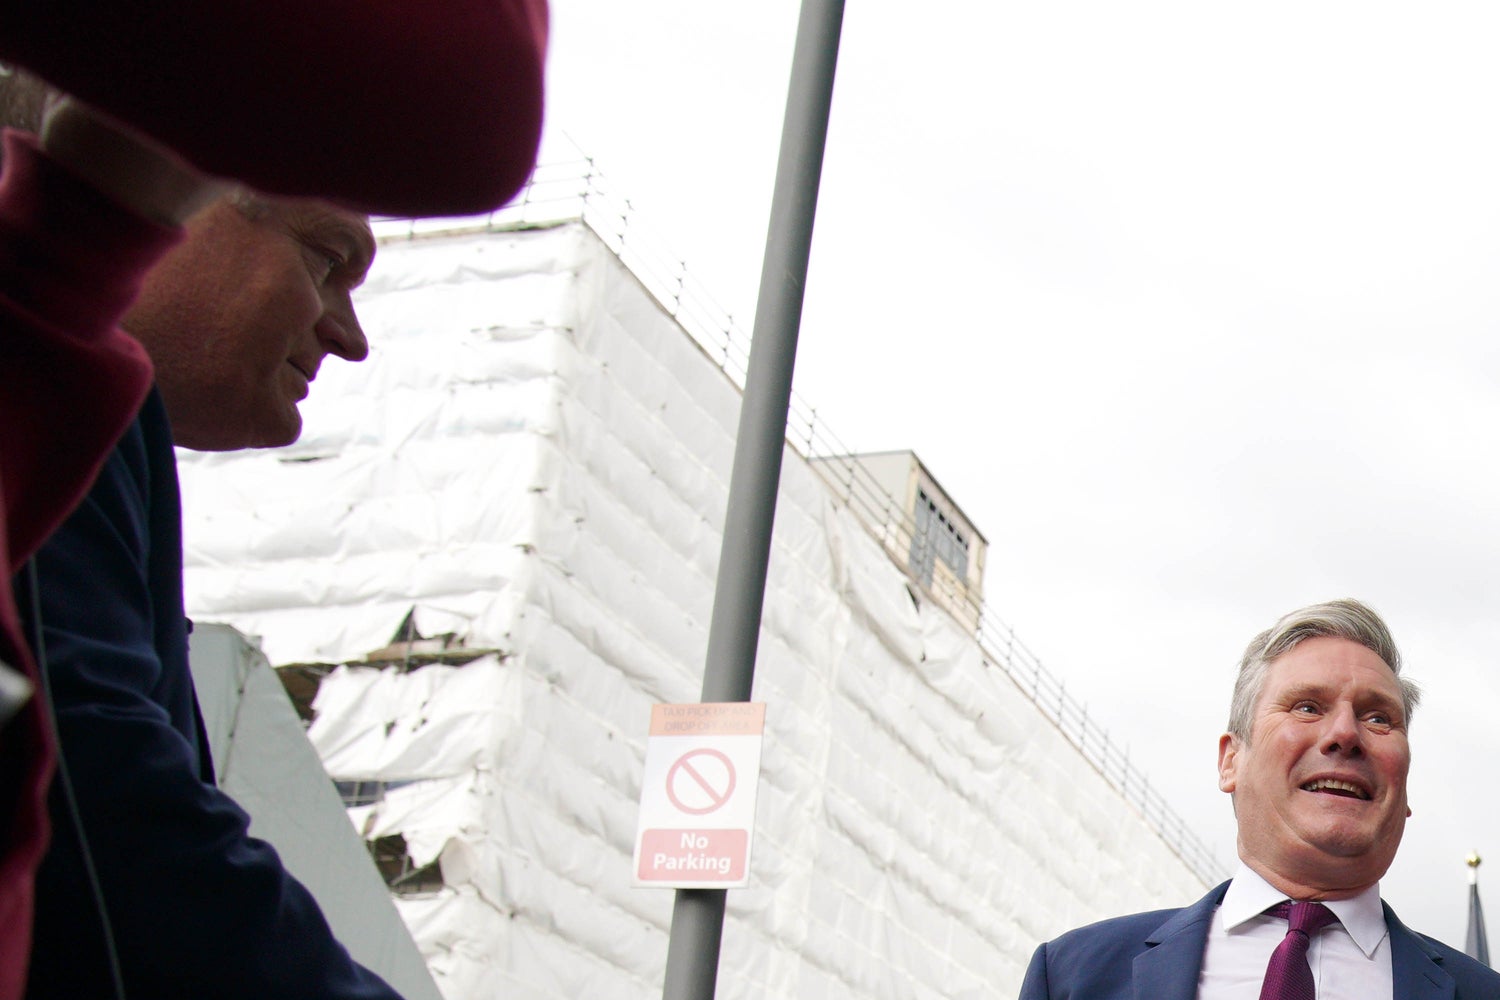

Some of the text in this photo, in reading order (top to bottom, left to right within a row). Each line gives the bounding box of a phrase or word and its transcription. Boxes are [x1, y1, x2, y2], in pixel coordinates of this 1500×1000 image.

[687, 707, 711, 717] PICK
[681, 832, 708, 849] No
[653, 853, 731, 874] Parking
